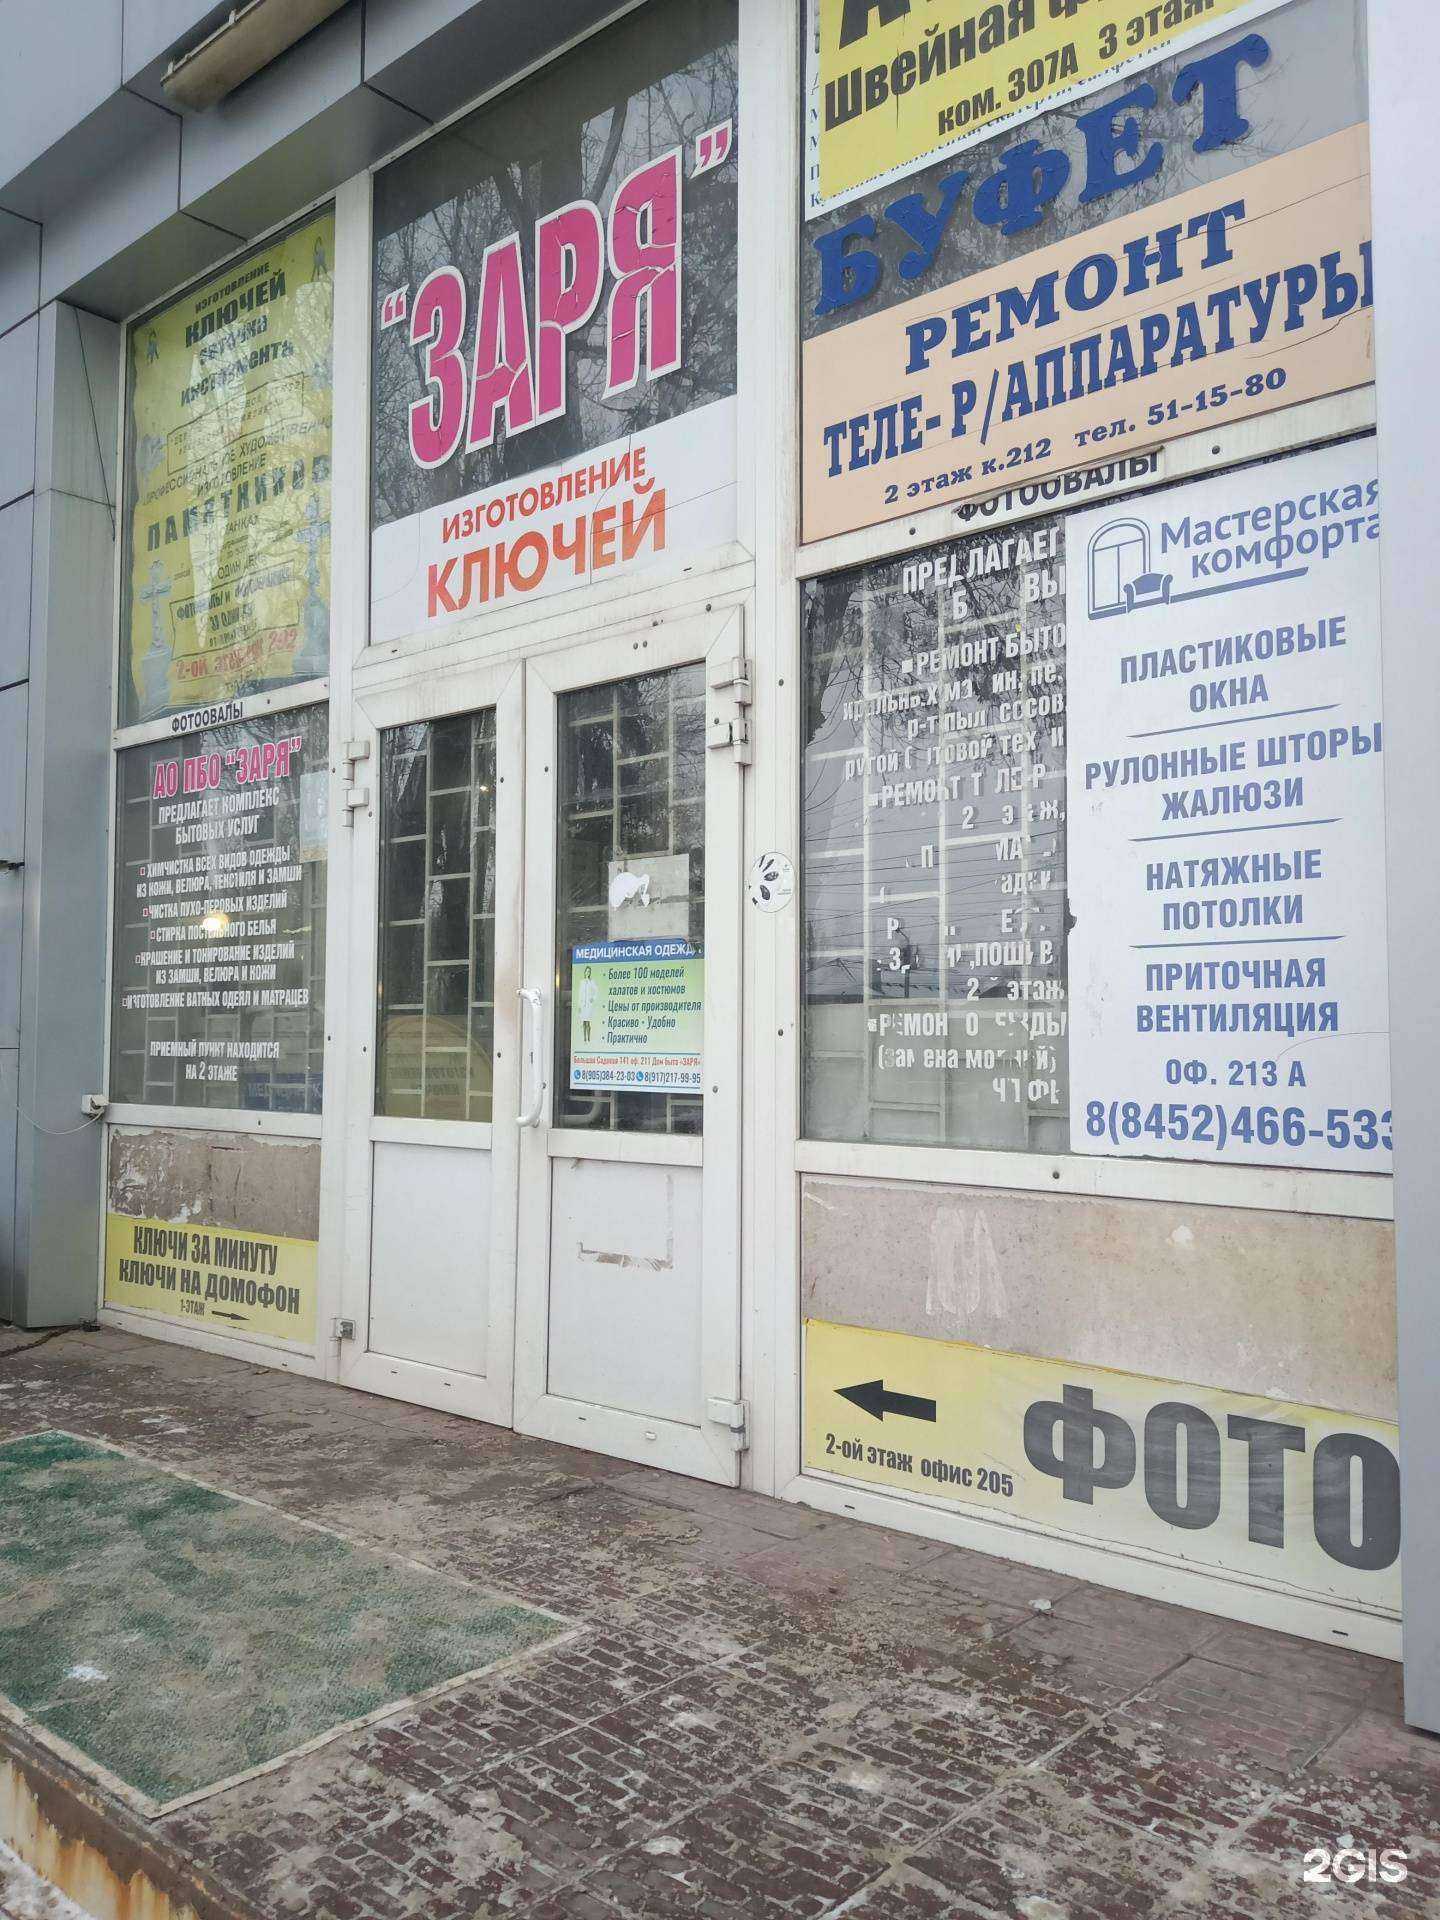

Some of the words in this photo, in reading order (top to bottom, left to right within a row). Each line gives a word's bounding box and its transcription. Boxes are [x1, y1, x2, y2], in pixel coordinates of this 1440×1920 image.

[825, 0, 1035, 131] Швейная
[938, 87, 1001, 136] ком.
[1008, 42, 1079, 103] 307А
[1098, 23, 1118, 60] 3
[813, 33, 1270, 317] БУФЕТ
[195, 262, 270, 314] ИЗГОТОВЛЕНИЕ
[380, 117, 733, 470] “ЗАРЯ”
[905, 199, 1245, 375] РЕМОНТ
[185, 269, 286, 348] КЛЮЧЕЙ
[884, 484, 899, 505] 2
[906, 464, 973, 498] этаж
[981, 438, 1052, 475] к.212
[1074, 417, 1136, 447] тел.
[1147, 367, 1287, 425] 51-15-80
[443, 446, 646, 543] ИЗГОТОВЛЕНИЕ
[1161, 479, 1379, 554] Мастерская
[427, 477, 666, 618] КЛЮЧЕЙ
[917, 637, 998, 676] РЕМОНТ
[1121, 615, 1346, 684] ПЛАСТИКОВЫЕ
[1189, 674, 1269, 713] ОКНА
[171, 702, 243, 732] ФОТООВАЛЫ
[1085, 742, 1246, 790] РУЛОННЫЕ
[1257, 722, 1383, 767] ШТОРЫ
[153, 762, 178, 799] АО
[183, 753, 221, 793] ПБО
[158, 796, 218, 824] ПРЕДЛАГАЕТ
[222, 787, 279, 813] КОМПЛЕКС
[1162, 777, 1304, 821] ЖАЛЮЗИ
[175, 820, 224, 845] БЫТОВЫХ
[227, 815, 260, 837] УСЛУГ
[146, 858, 194, 878] ХИМЧИСТКА
[195, 855, 216, 873] ВСЕХ
[218, 852, 247, 870] ВИДОВ
[250, 845, 290, 867] ОДЕЖДЫ
[1146, 849, 1322, 891] НАТЯЖНЫЕ
[136, 883, 147, 898] ИЗ
[214, 871, 256, 890] ТЕКСТИЛЯ
[258, 869, 265, 884] И
[267, 865, 302, 883] ЗАМШИ
[149, 902, 178, 919] ЧИСТКА
[246, 889, 287, 911] ИЗДЕЛИЙ
[1163, 894, 1304, 930] ПОТОЛКИ
[156, 926, 186, 942] СТИРКА
[248, 918, 277, 935] БЕЛЬЯ
[140, 949, 183, 966] КРАШЕНИЕ
[185, 948, 191, 964] И
[193, 945, 250, 963] ТОНИРОВАНИЕ
[252, 940, 295, 962] ИЗДЕЛИЙ
[575, 946, 652, 959] МЕДИЦИНСКАЯ
[654, 943, 702, 957] ОДЕЖД
[156, 969, 166, 984] ИЗ
[168, 967, 202, 985] ЗАМШИ,
[203, 965, 239, 982] ВЕЛЮРА
[241, 966, 248, 981] И
[250, 964, 276, 980] КОЖИ
[608, 968, 631, 980] Более
[634, 967, 648, 979] 100
[649, 966, 684, 980] моделей
[608, 985, 638, 996] халатов
[640, 986, 645, 995] и
[647, 985, 685, 996] костюмов
[1146, 958, 1326, 991] ПРИТОЧНАЯ
[127, 991, 185, 1009] ИЗГОТОВЛЕНИЕ
[187, 990, 220, 1007] ВАТНЫХ
[222, 990, 250, 1008] ОДЕЯЛ
[253, 990, 259, 1005] И
[261, 988, 309, 1008] МАТРАЦЕВ
[608, 1000, 629, 1013] Цены
[632, 1002, 640, 1012] от
[641, 1000, 702, 1014] производителя
[606, 1031, 648, 1045] Практично
[607, 1016, 639, 1030] Красиво
[647, 1015, 676, 1030] Удобно
[1137, 1002, 1339, 1037] ВЕНТИЛЯЦИЯ
[150, 1038, 197, 1057] ПРИЕМНЫЙ
[198, 1041, 225, 1057] ПУНКТ
[227, 1041, 279, 1060] НАХОДИТСЯ
[186, 1064, 197, 1080] НА
[199, 1062, 206, 1079] 2
[208, 1064, 238, 1081] ЭТАЖЕ
[1166, 1059, 1217, 1086] ОФ.
[1228, 1060, 1278, 1087] 213
[1288, 1060, 1307, 1087] А
[133, 1226, 188, 1261] КЛЮЧИ
[191, 1234, 211, 1265] ЗА
[214, 1237, 278, 1276] МИНУТУ
[119, 1259, 176, 1291] КЛЮЧИ
[180, 1270, 201, 1295] НА
[204, 1273, 300, 1315] ДОМОФОН
[180, 1299, 205, 1316] 1-ЭТАЖ
[825, 1432, 864, 1464] 2-ой
[867, 1441, 912, 1473] этаж
[920, 1454, 972, 1484] офис
[976, 1466, 1014, 1498] 205
[1023, 1383, 1401, 1571] ФОТО
